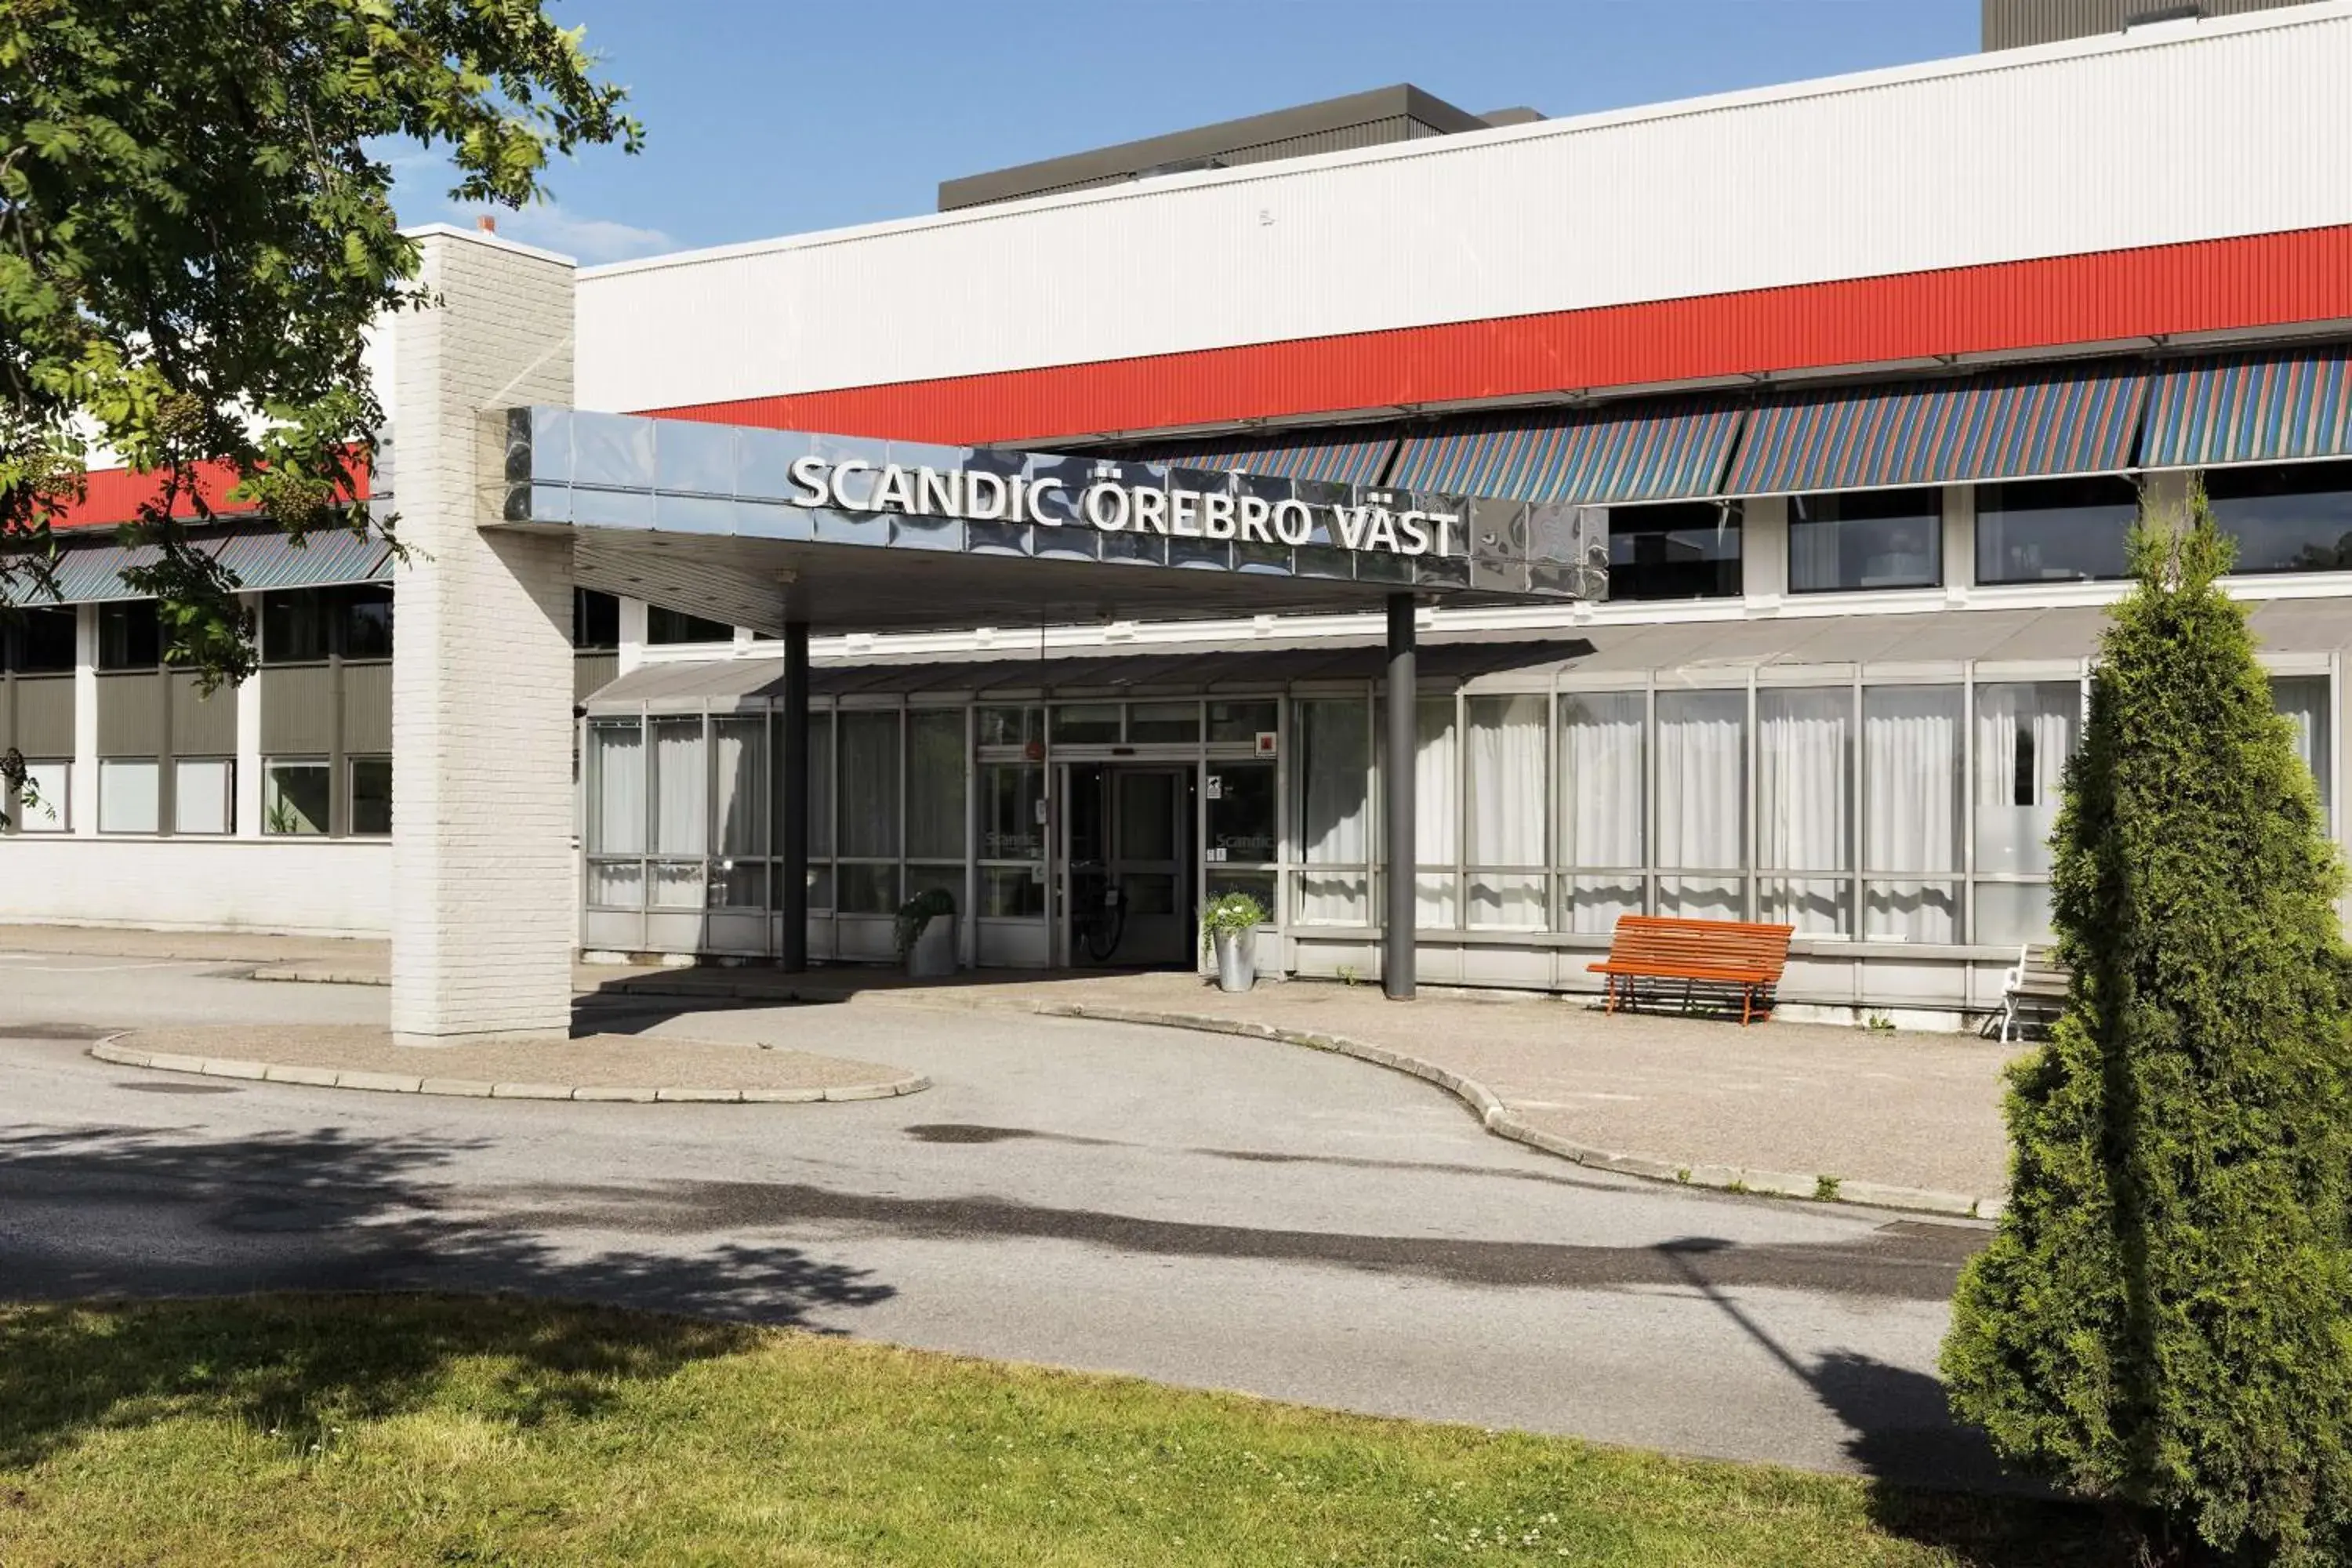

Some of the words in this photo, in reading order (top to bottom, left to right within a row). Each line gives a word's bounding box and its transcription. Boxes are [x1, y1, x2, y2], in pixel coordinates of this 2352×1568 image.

[789, 456, 1062, 526] SCANDIC
[1085, 468, 1312, 545] ÖREBRO
[1334, 492, 1459, 556] VÄST
